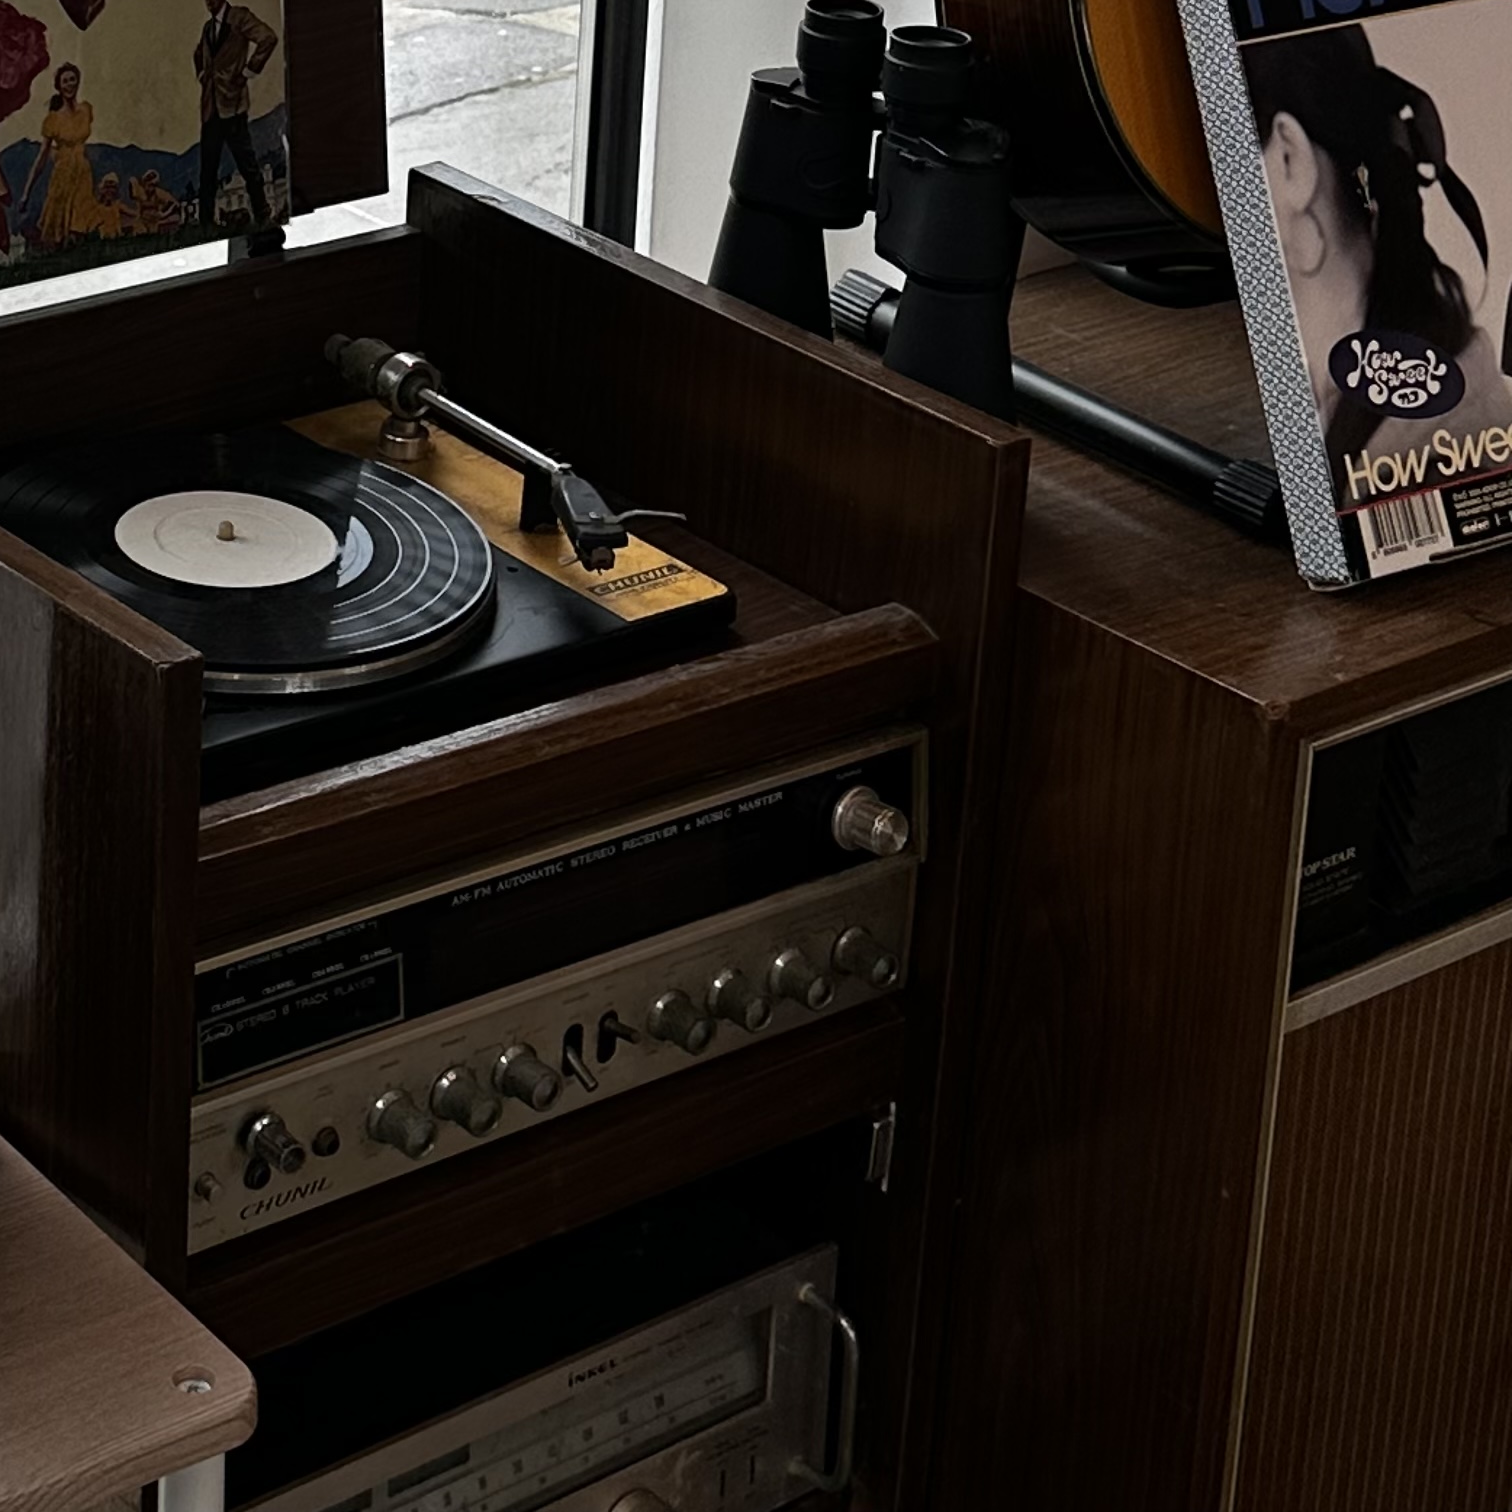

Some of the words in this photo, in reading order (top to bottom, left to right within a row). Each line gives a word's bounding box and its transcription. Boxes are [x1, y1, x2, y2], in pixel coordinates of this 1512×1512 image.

[1346, 339, 1402, 388] How
[1367, 349, 1448, 406] Sweet
[1432, 426, 1512, 477] Swe
[495, 860, 565, 893] AUTOMATIC
[569, 844, 617, 869] STEREO
[621, 825, 679, 852] RECEIVER
[694, 806, 733, 829] MUSIC
[737, 791, 783, 815] MASTER
[235, 1008, 278, 1033] STEREO
[239, 1176, 334, 1221] CHUNIL
